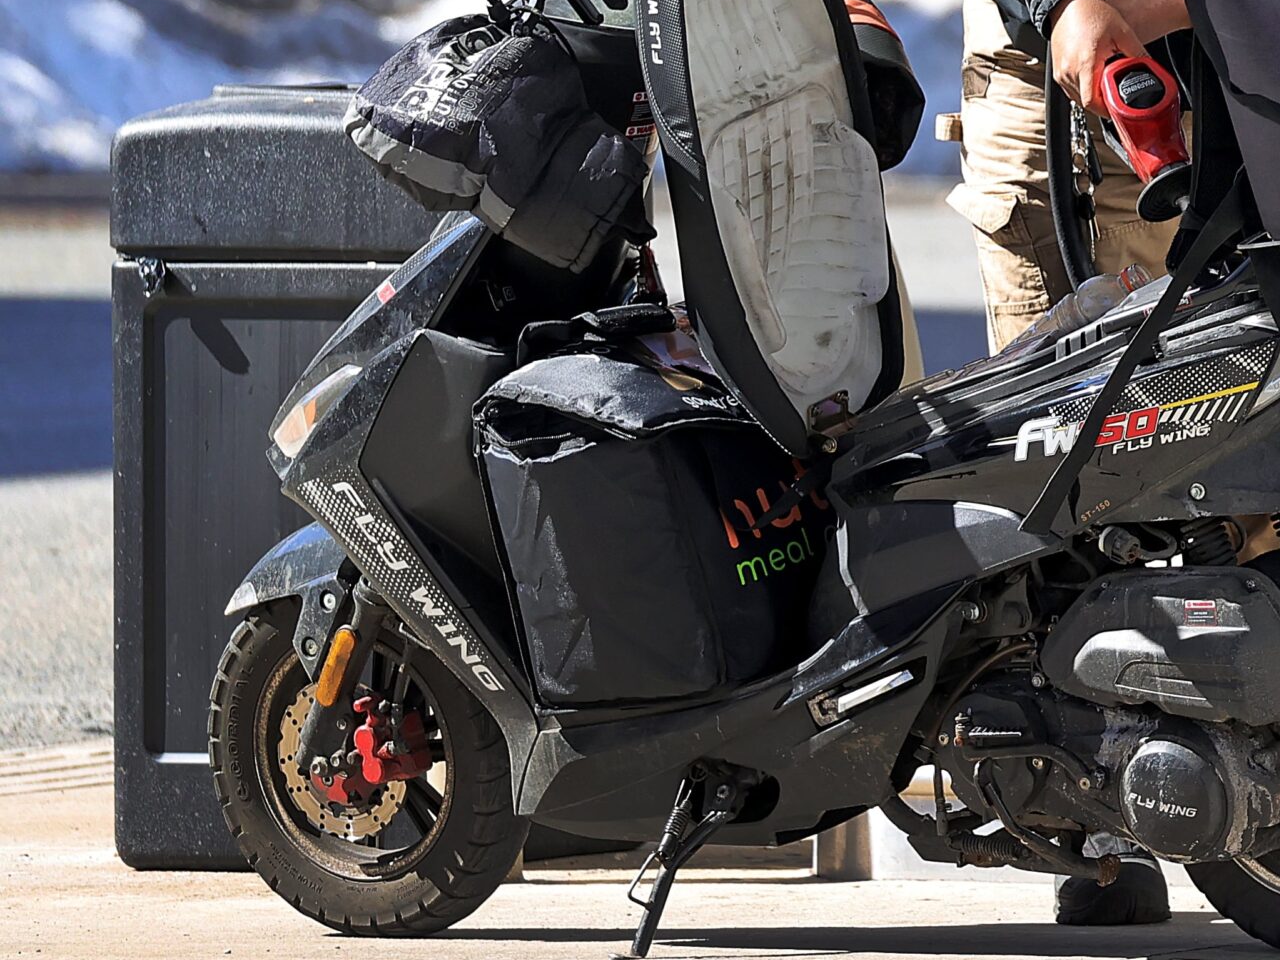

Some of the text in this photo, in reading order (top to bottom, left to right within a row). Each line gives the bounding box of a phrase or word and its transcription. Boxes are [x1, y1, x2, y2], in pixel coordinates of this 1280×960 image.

[646, 23, 663, 65] FLY
[1112, 425, 1210, 455] FLY WING
[1080, 499, 1111, 522] ST-150
[736, 528, 814, 586] meal
[332, 481, 505, 691] FLY WING
[1128, 792, 1198, 818] FLY WING
